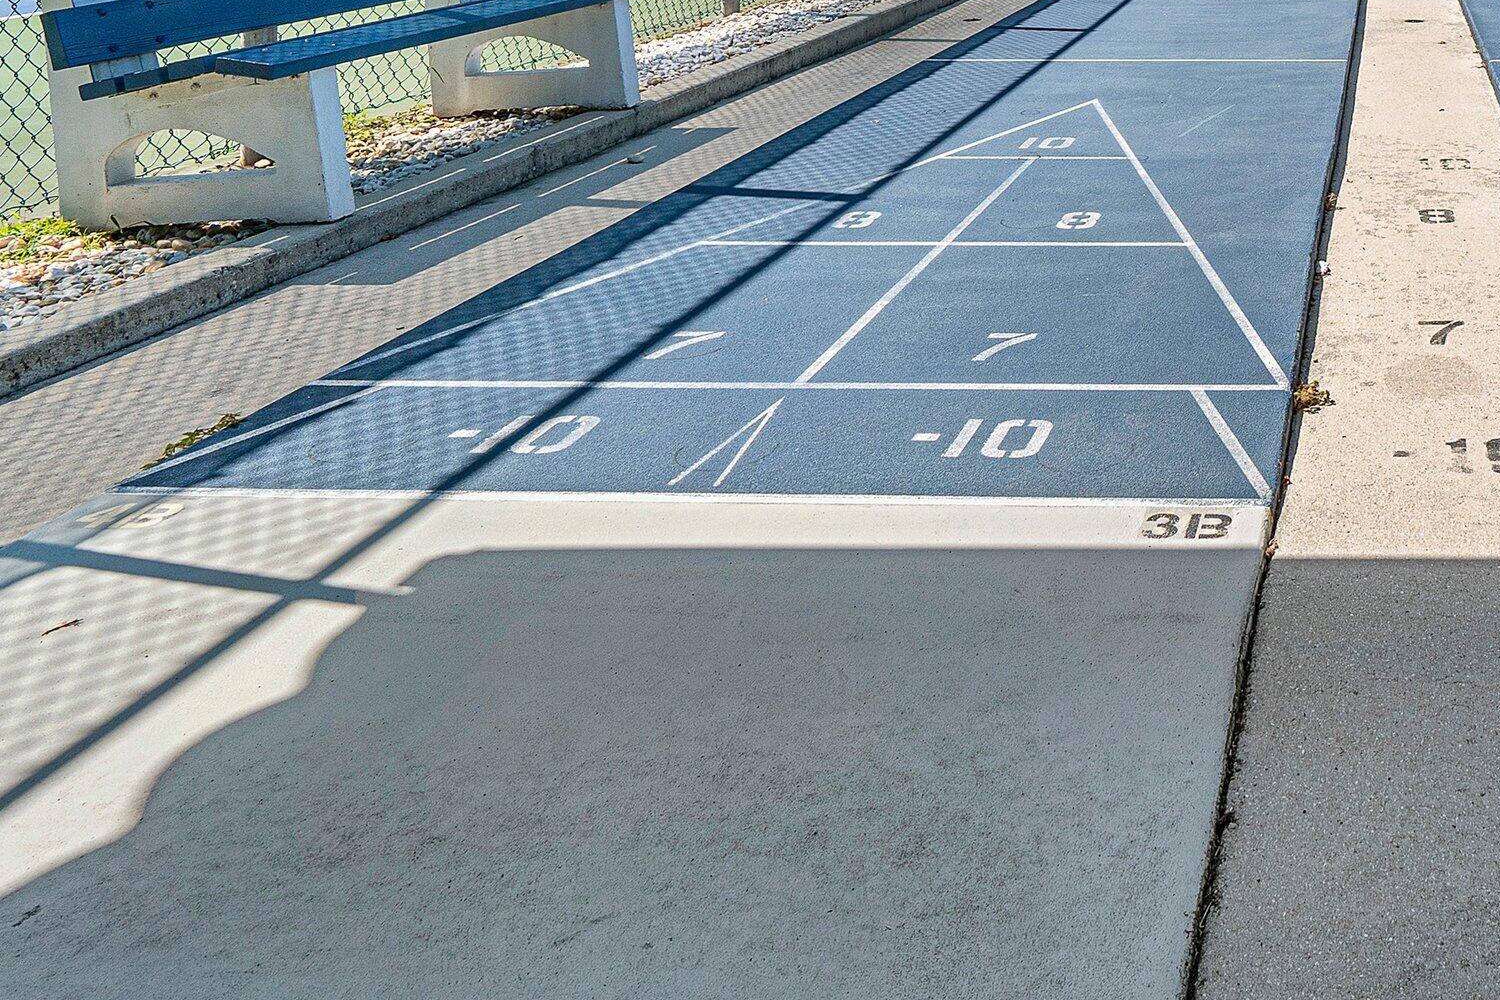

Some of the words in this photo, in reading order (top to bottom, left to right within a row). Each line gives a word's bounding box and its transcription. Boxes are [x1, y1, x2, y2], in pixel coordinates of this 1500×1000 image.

[1016, 136, 1078, 150] 10
[831, 210, 883, 229] 8
[1056, 211, 1102, 230] 8
[1419, 209, 1455, 224] 8
[1418, 320, 1465, 345] 7
[643, 331, 727, 360] 7
[970, 332, 1038, 362] 7
[446, 414, 602, 455] -10
[911, 418, 1053, 459] -10
[1141, 513, 1232, 539] 3B
